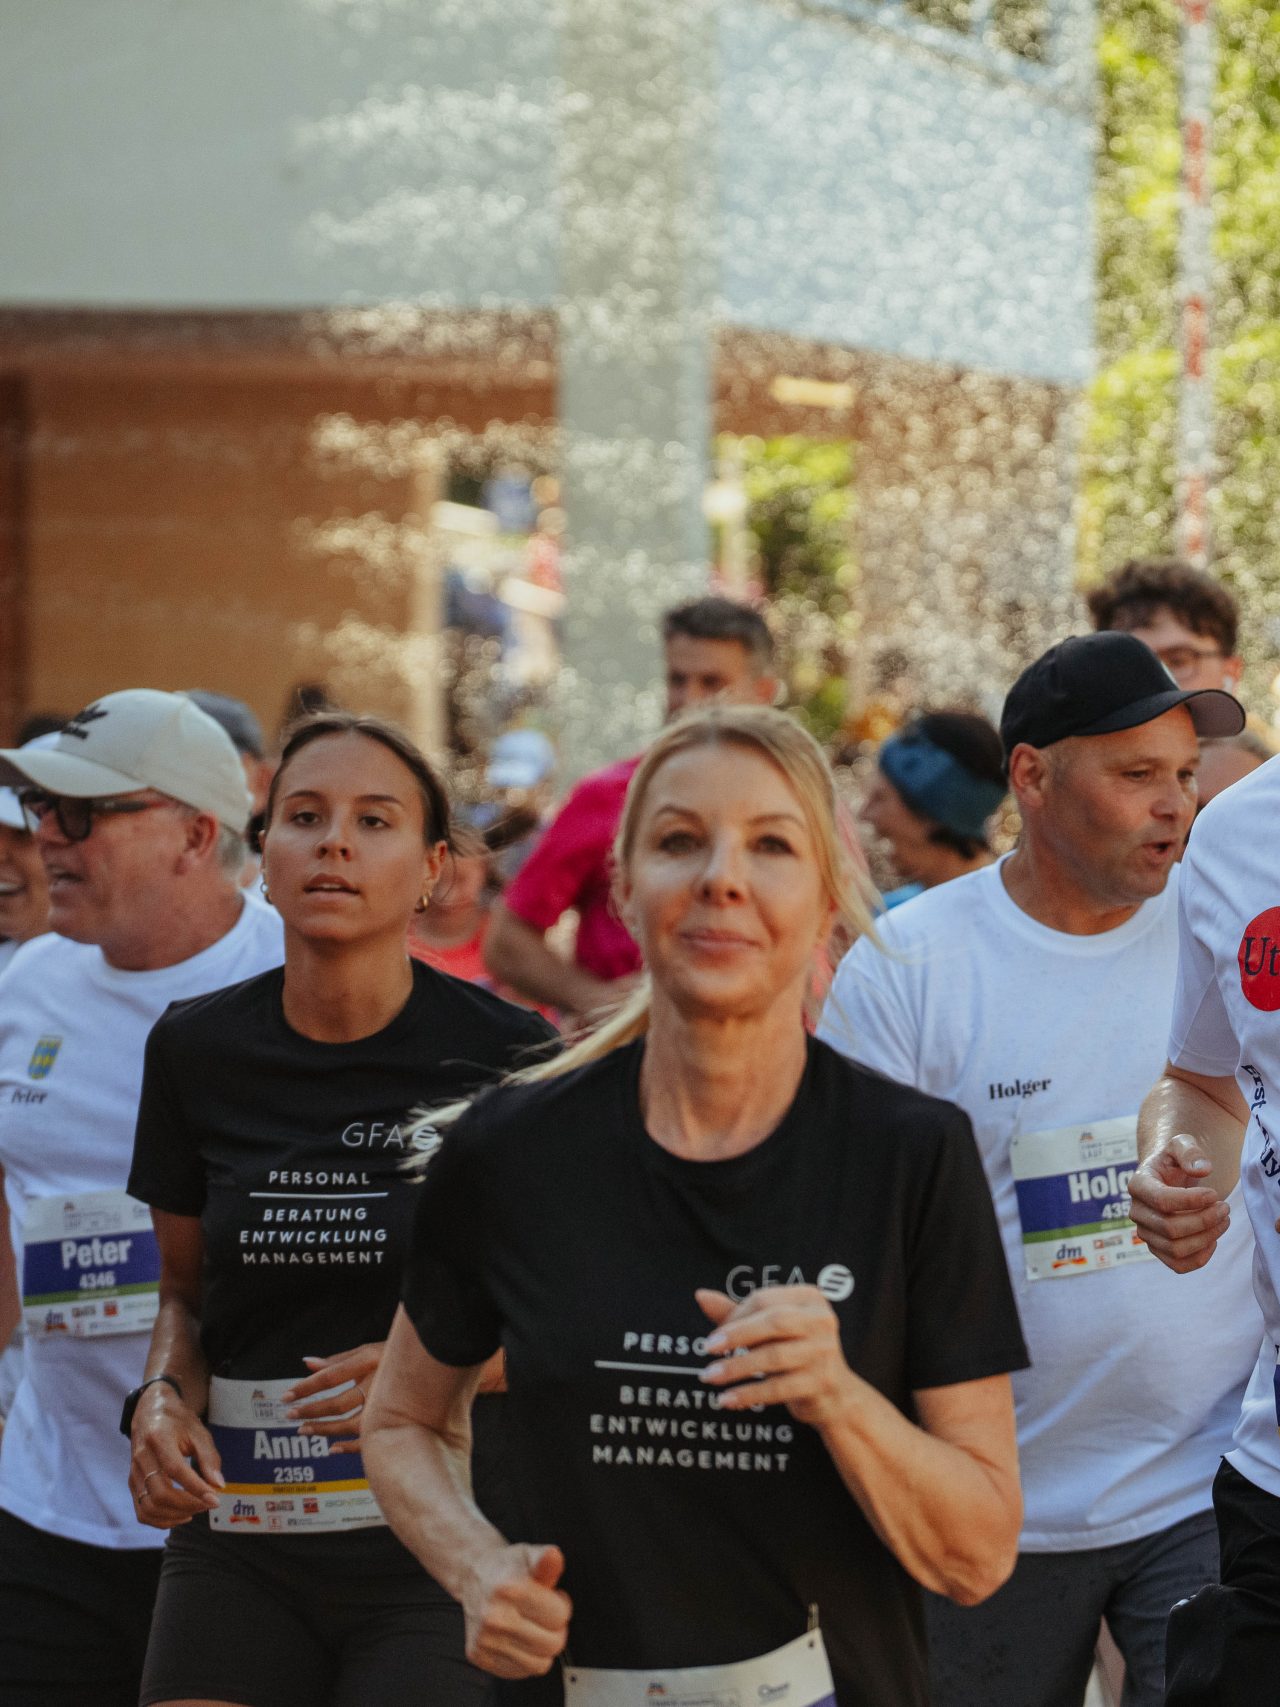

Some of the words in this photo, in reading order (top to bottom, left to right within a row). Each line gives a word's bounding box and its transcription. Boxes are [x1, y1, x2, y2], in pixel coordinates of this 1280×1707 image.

[989, 1078, 1051, 1099] Holger
[341, 1122, 404, 1148] GFA
[268, 1170, 370, 1185] PERSONAL
[1068, 1168, 1134, 1204] Holg
[263, 1207, 368, 1222] BERATUNG
[1102, 1201, 1131, 1219] 435
[239, 1229, 388, 1244] ENTWICKLUNG
[61, 1238, 132, 1270] Peter
[242, 1251, 384, 1264] MANAGEMENT
[1056, 1245, 1082, 1259] dm
[79, 1271, 116, 1289] 4346
[725, 1264, 807, 1300] GFA
[619, 1385, 766, 1413] BERATU
[590, 1413, 795, 1443] ENTWICKLUNG
[254, 1431, 330, 1460] Anna
[592, 1445, 790, 1472] MANAGEMENT
[273, 1466, 314, 1483] 2359
[233, 1500, 256, 1515] dm
